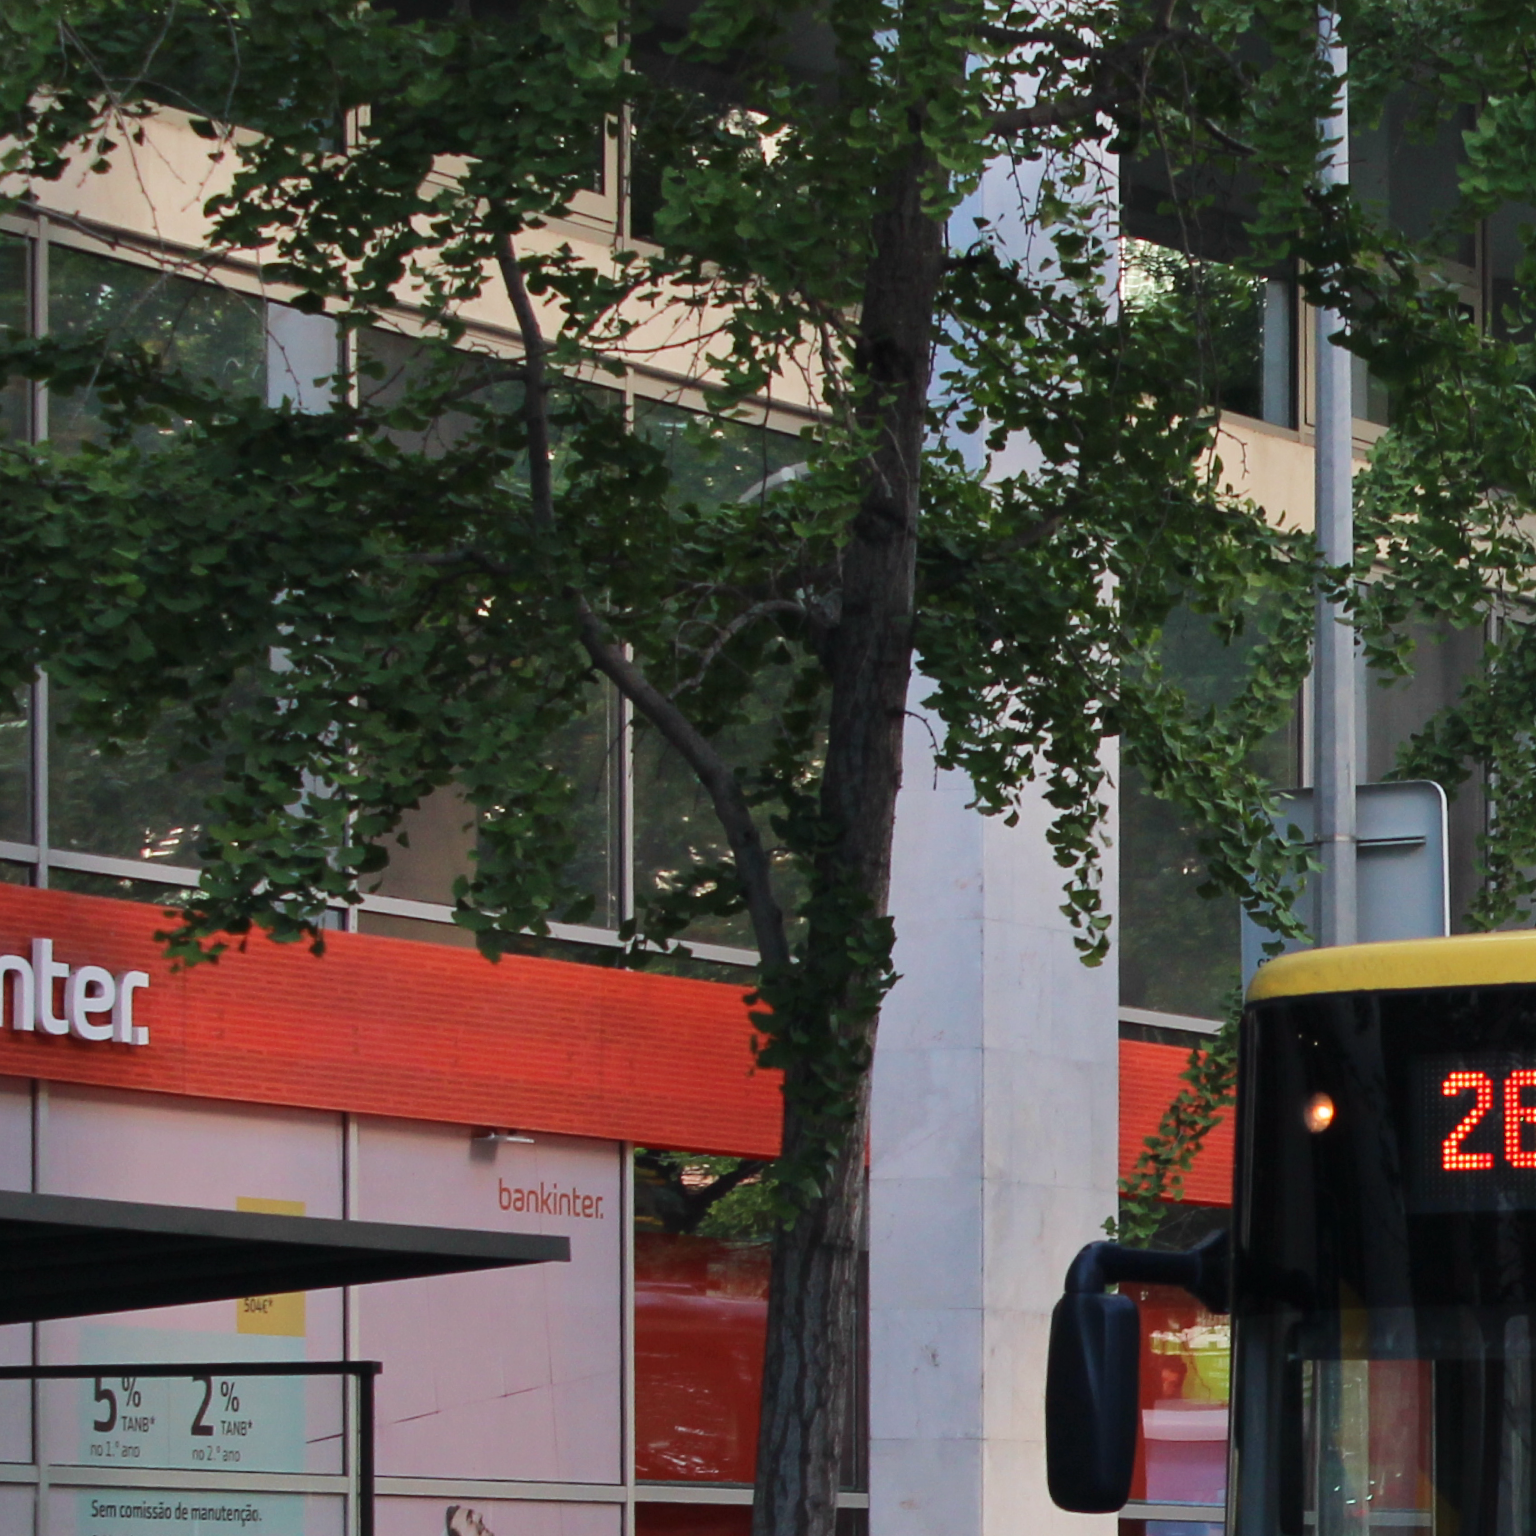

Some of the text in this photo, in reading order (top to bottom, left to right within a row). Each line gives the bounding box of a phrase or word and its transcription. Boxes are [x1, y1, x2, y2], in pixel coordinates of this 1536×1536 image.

[499, 1178, 604, 1220] bankinter.
[121, 1445, 140, 1458] ano
[222, 1449, 241, 1462] ano
[91, 1500, 262, 1527] Sem comissão de manutenção.
